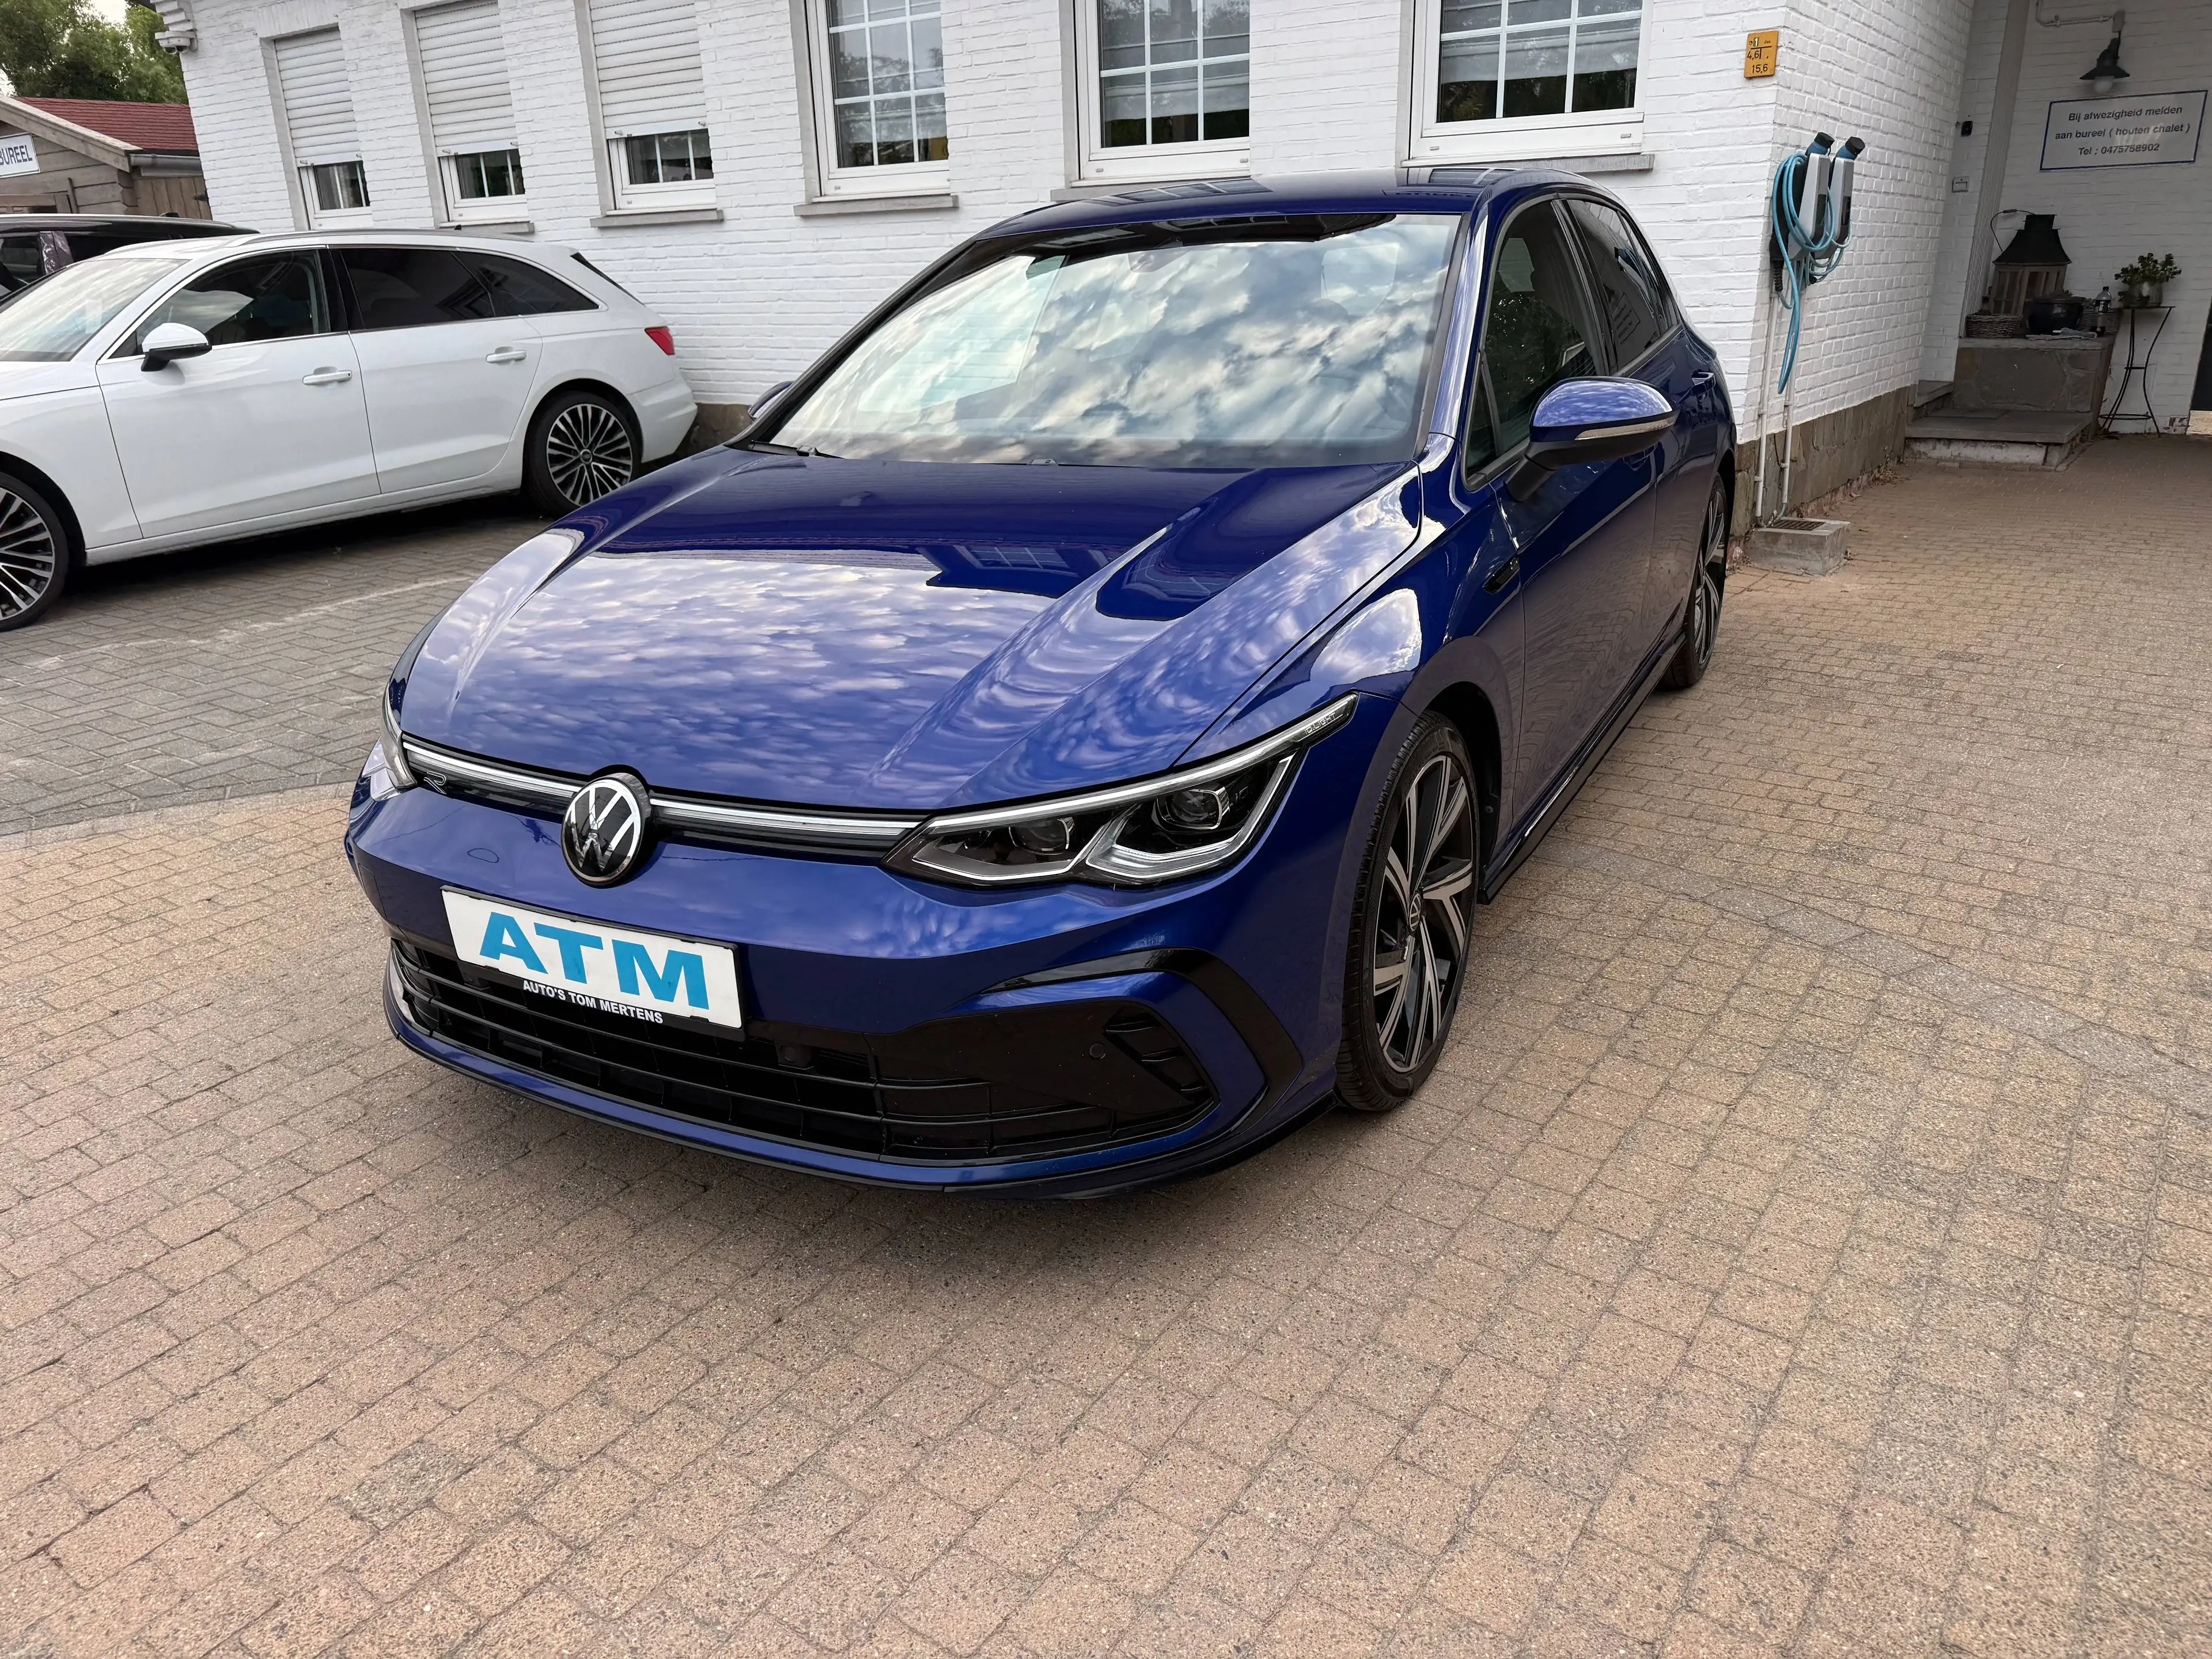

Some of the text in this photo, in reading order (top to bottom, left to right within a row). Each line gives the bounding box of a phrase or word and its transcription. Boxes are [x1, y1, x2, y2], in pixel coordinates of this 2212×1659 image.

[1747, 50, 1759, 60] 4,6
[1752, 64, 1768, 73] 15,6
[2069, 107, 2182, 122] Bij afwezigheid melden
[2075, 128, 2105, 138] bureel
[2116, 127, 2150, 135] houten
[2153, 123, 2183, 133] chalet
[0, 145, 33, 165] BUREEL
[2078, 147, 2092, 155] Tel
[480, 912, 709, 1009] ATM
[523, 980, 663, 1024] AUTO'S TOM MERTENS
